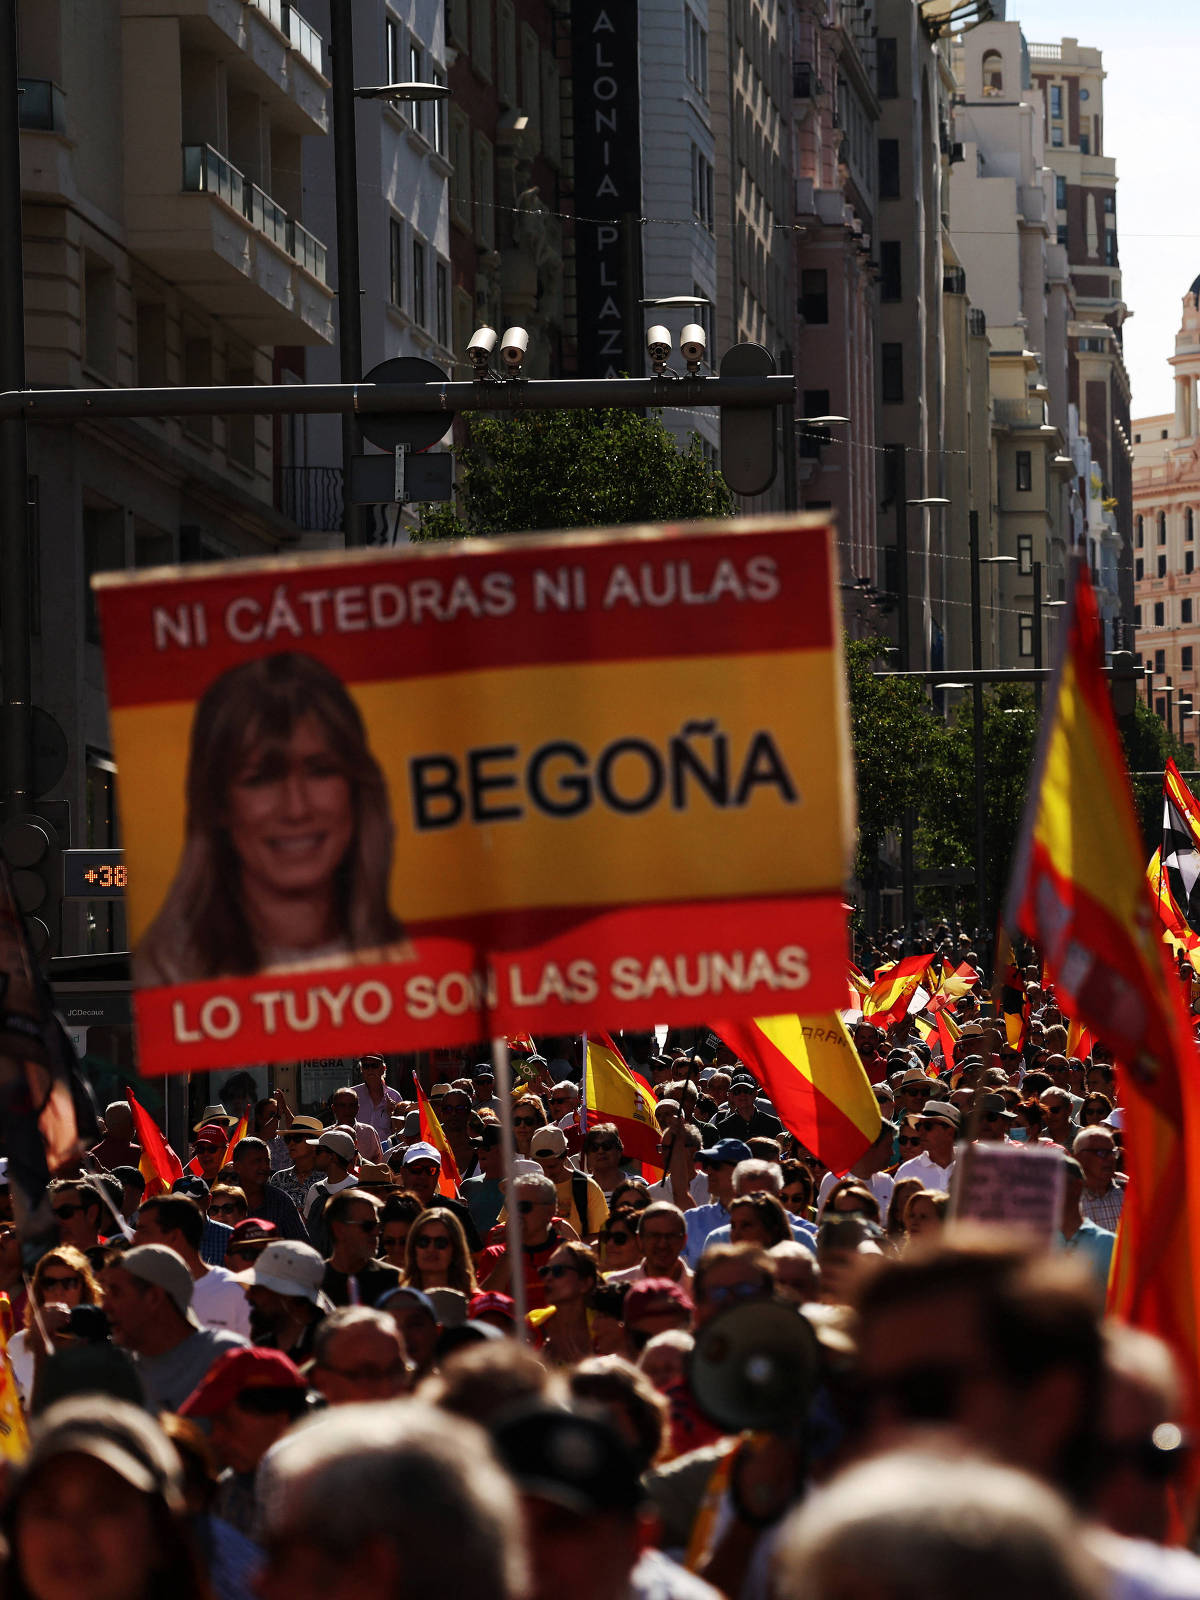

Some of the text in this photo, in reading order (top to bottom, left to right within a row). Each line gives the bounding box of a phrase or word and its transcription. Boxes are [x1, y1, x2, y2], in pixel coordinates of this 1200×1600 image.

[592, 9, 622, 379] ALONIA PLAZA
[152, 556, 781, 649] NI CÁTEDRAS NI AULAS
[409, 718, 799, 832] BEGOÑA
[83, 864, 128, 888] +38
[68, 1009, 104, 1017] JCDecaux
[172, 945, 810, 1043] LO TUYO SON LAS SAUNAS
[304, 1059, 344, 1068] NEGRA
[520, 1063, 536, 1076] VOX
